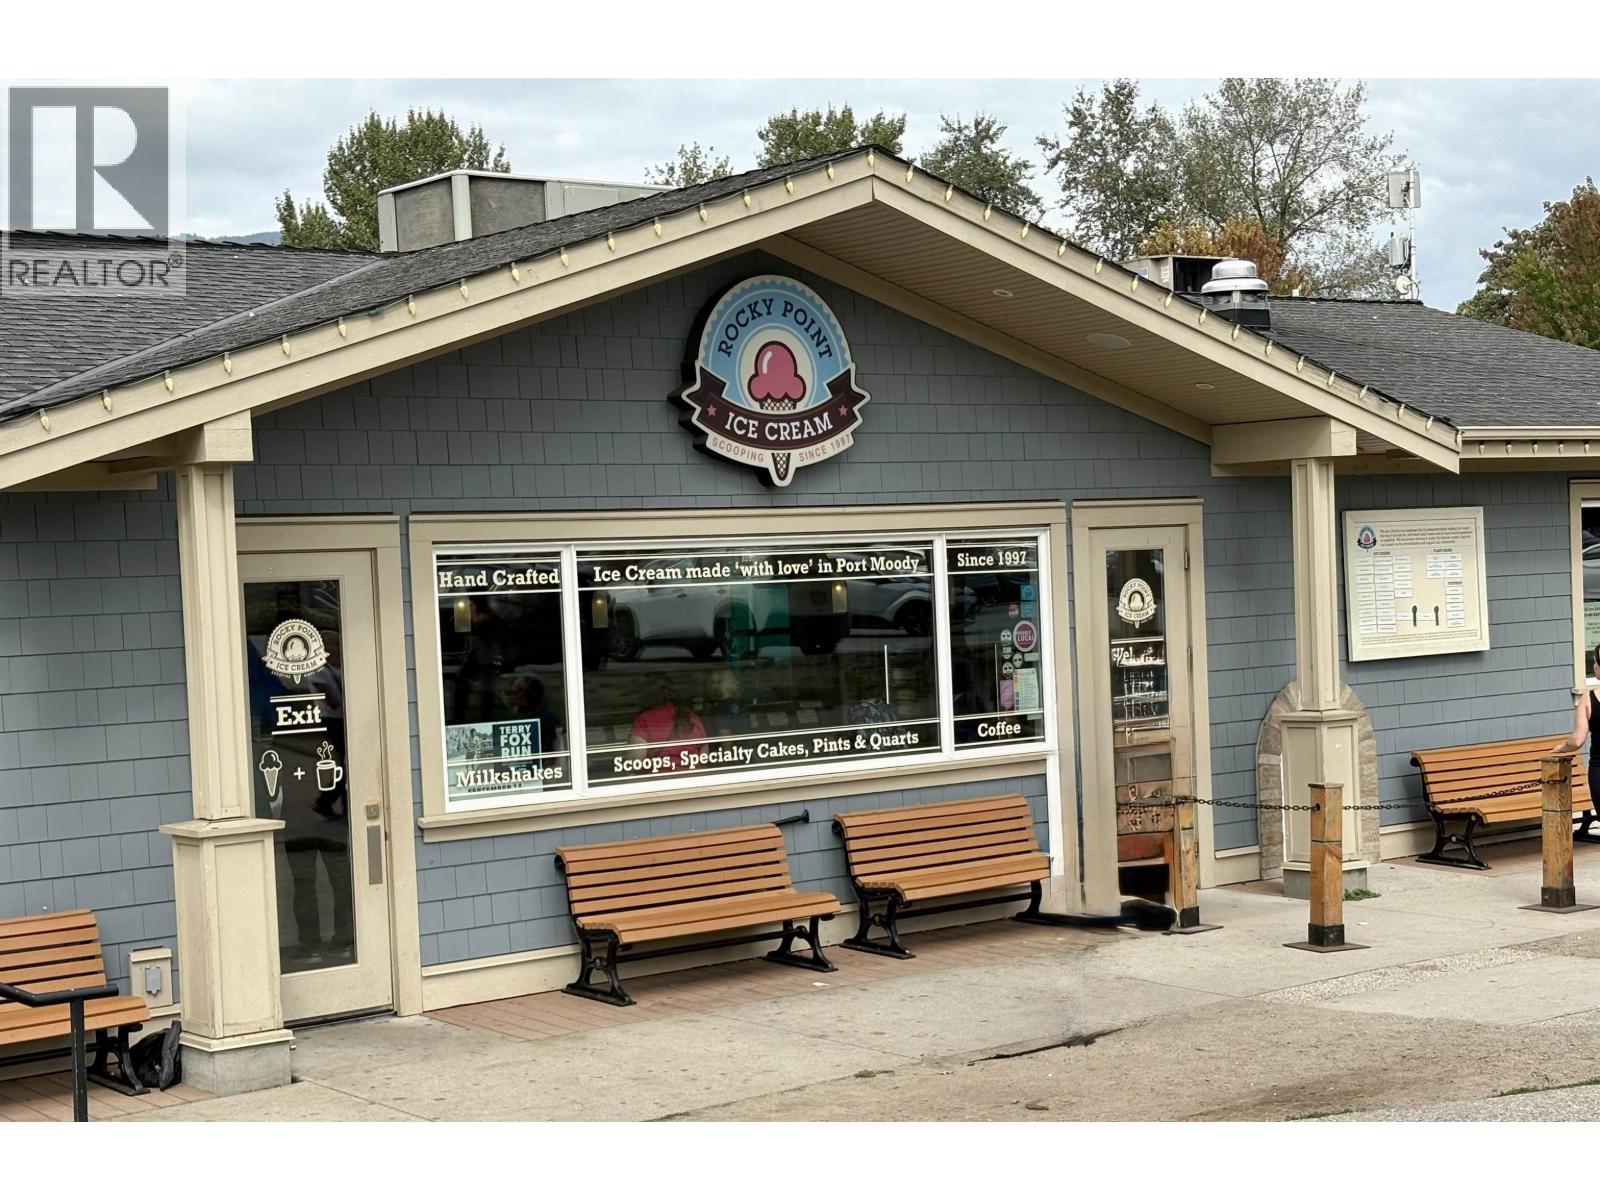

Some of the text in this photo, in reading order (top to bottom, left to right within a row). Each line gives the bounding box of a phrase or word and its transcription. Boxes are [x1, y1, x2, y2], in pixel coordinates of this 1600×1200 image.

[718, 298, 833, 359] ROCKY POINT
[725, 411, 834, 441] ICE CREAM
[712, 437, 764, 463] SCOOPING
[798, 446, 828, 462] SINCE
[593, 566, 621, 582] Ice
[625, 564, 682, 581] Cream
[686, 562, 731, 578] made
[818, 560, 833, 573] in
[836, 557, 869, 573] Port
[870, 556, 919, 573] Moody
[957, 551, 1027, 567] Since 1997
[438, 568, 560, 588] Hand Crafted
[273, 624, 318, 646] ROCKY POINT
[276, 660, 317, 671] ICE CREAM
[276, 704, 322, 727] Exit
[499, 724, 532, 735] TERRY
[500, 733, 532, 747] FOX
[977, 721, 1021, 737] Coffee
[501, 745, 532, 759] RUN
[613, 730, 919, 773] Scoops, Specialty Cakes, Pints & Quarts
[456, 764, 563, 788] Milkshakes
